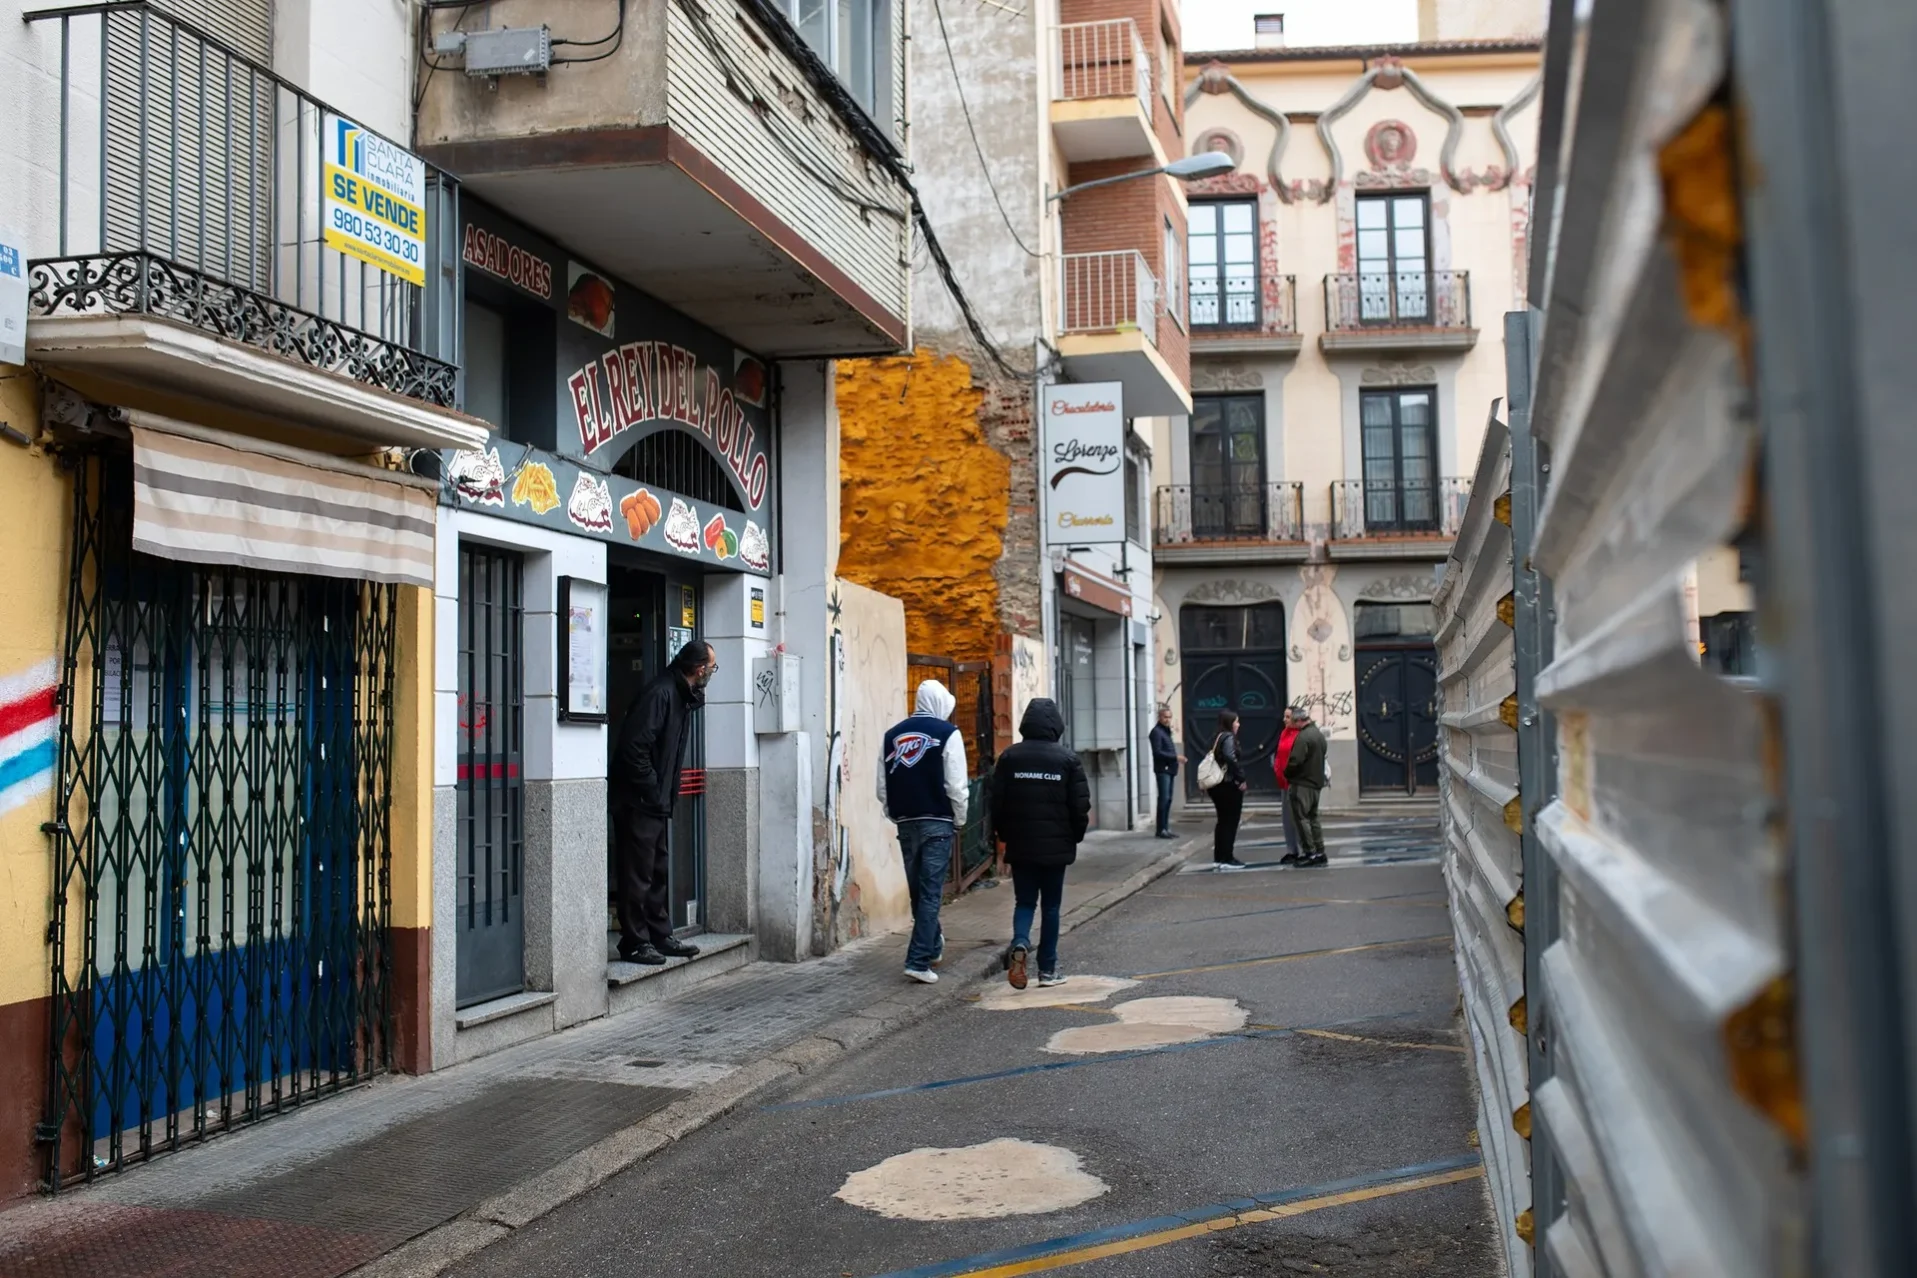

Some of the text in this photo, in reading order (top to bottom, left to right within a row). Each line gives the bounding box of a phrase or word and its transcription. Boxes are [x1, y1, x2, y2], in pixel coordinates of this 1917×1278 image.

[367, 135, 414, 173] SANTA
[367, 153, 414, 188] CLARA
[333, 173, 418, 234] SE VENDE
[367, 171, 415, 203] inmobiliaria
[334, 208, 418, 263] 980 53 30 30
[463, 223, 551, 300] ASADORES
[567, 340, 768, 512] EL REY DEL POLLO
[1054, 438, 1118, 463] Lorenzo
[1014, 772, 1062, 781] NONAME CLUB
